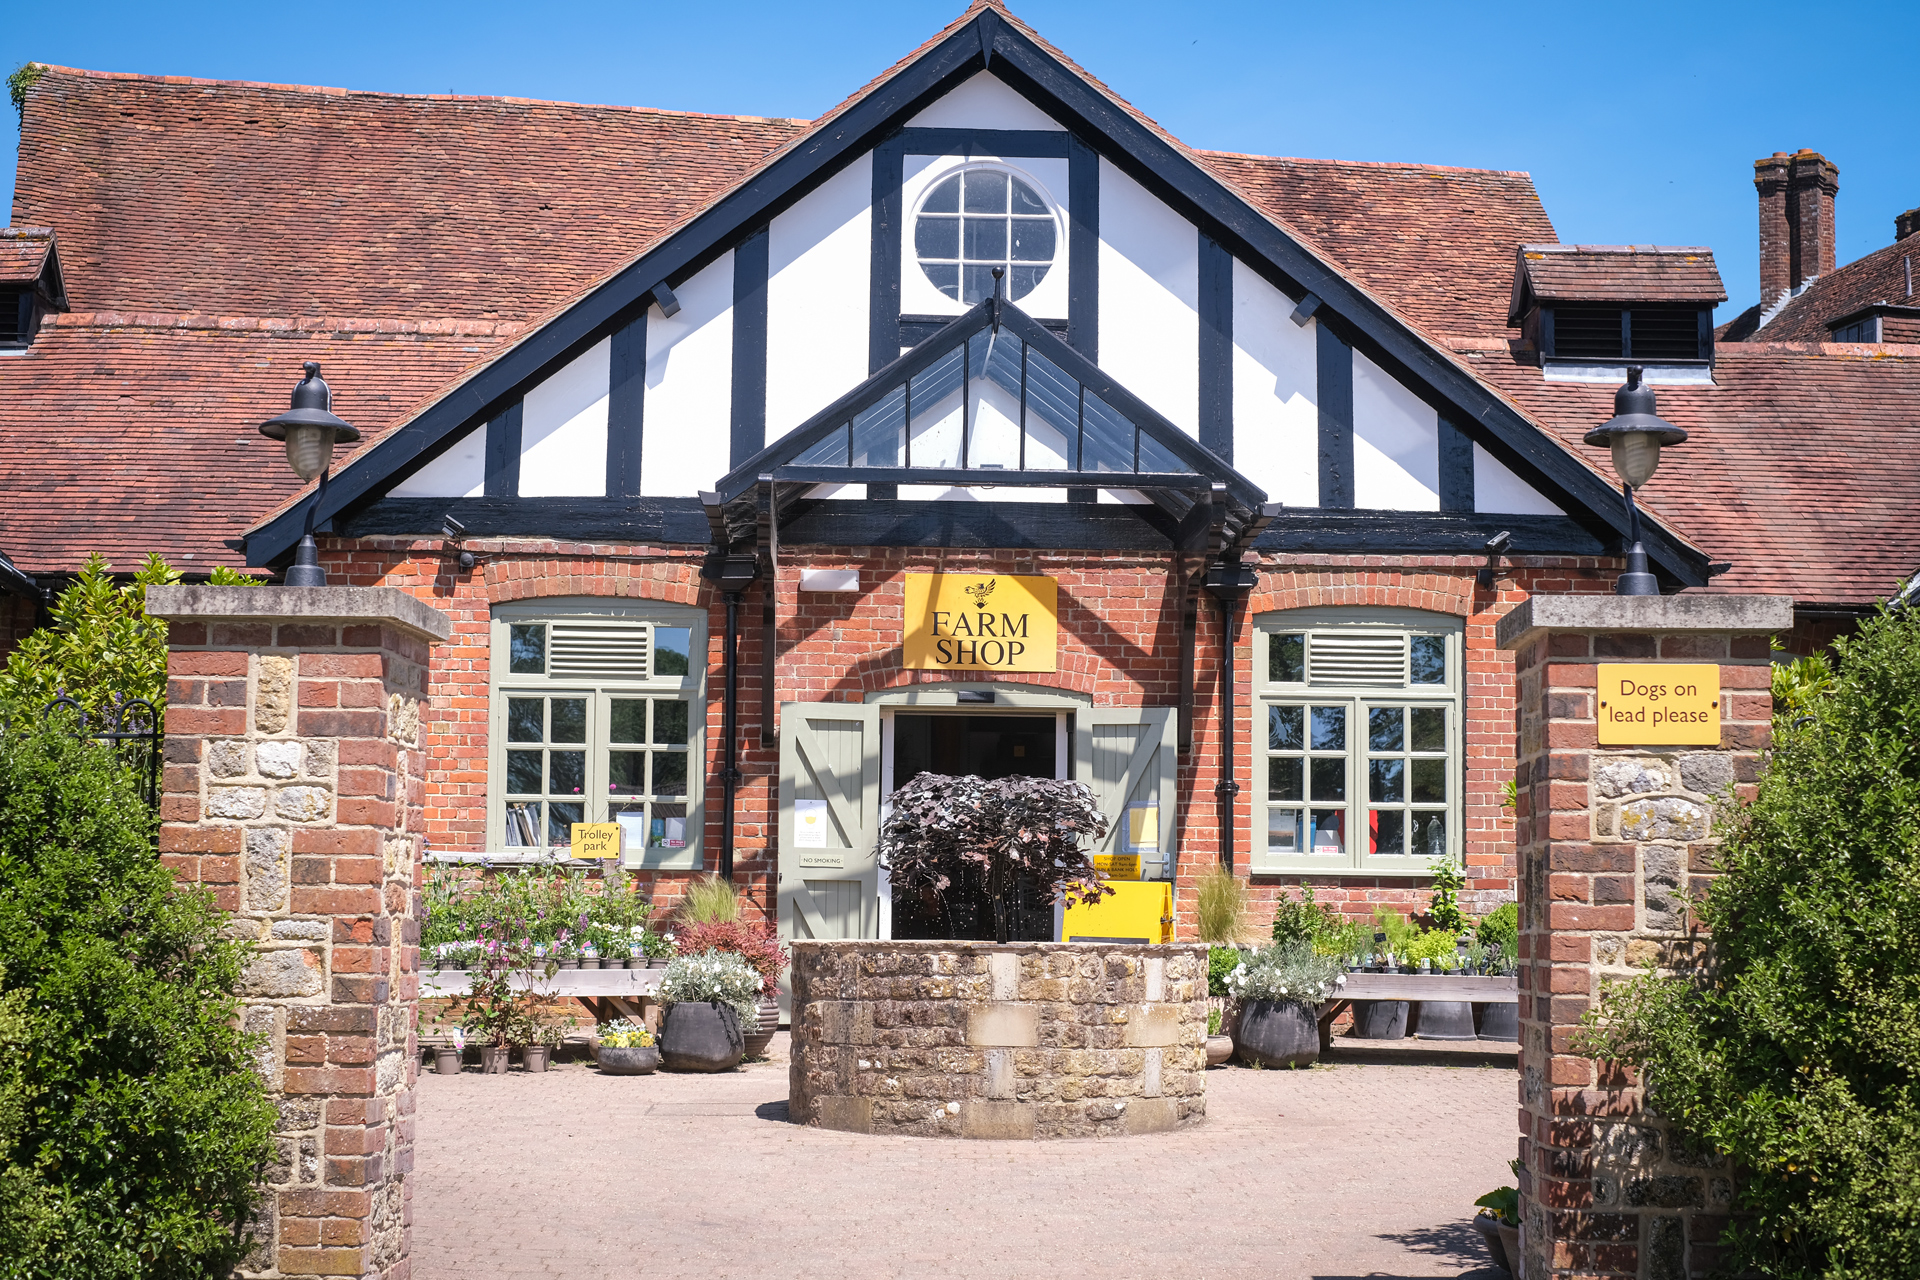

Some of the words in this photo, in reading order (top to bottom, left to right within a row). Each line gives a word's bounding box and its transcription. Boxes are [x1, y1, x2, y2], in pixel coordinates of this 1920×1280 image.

[931, 612, 1029, 638] FARM
[936, 639, 1025, 665] SHOP
[1621, 680, 1667, 701] Dogs
[1674, 685, 1697, 696] on
[1610, 706, 1645, 722] lead
[1653, 706, 1708, 727] please
[578, 829, 613, 842] Trolley
[584, 841, 607, 853] park
